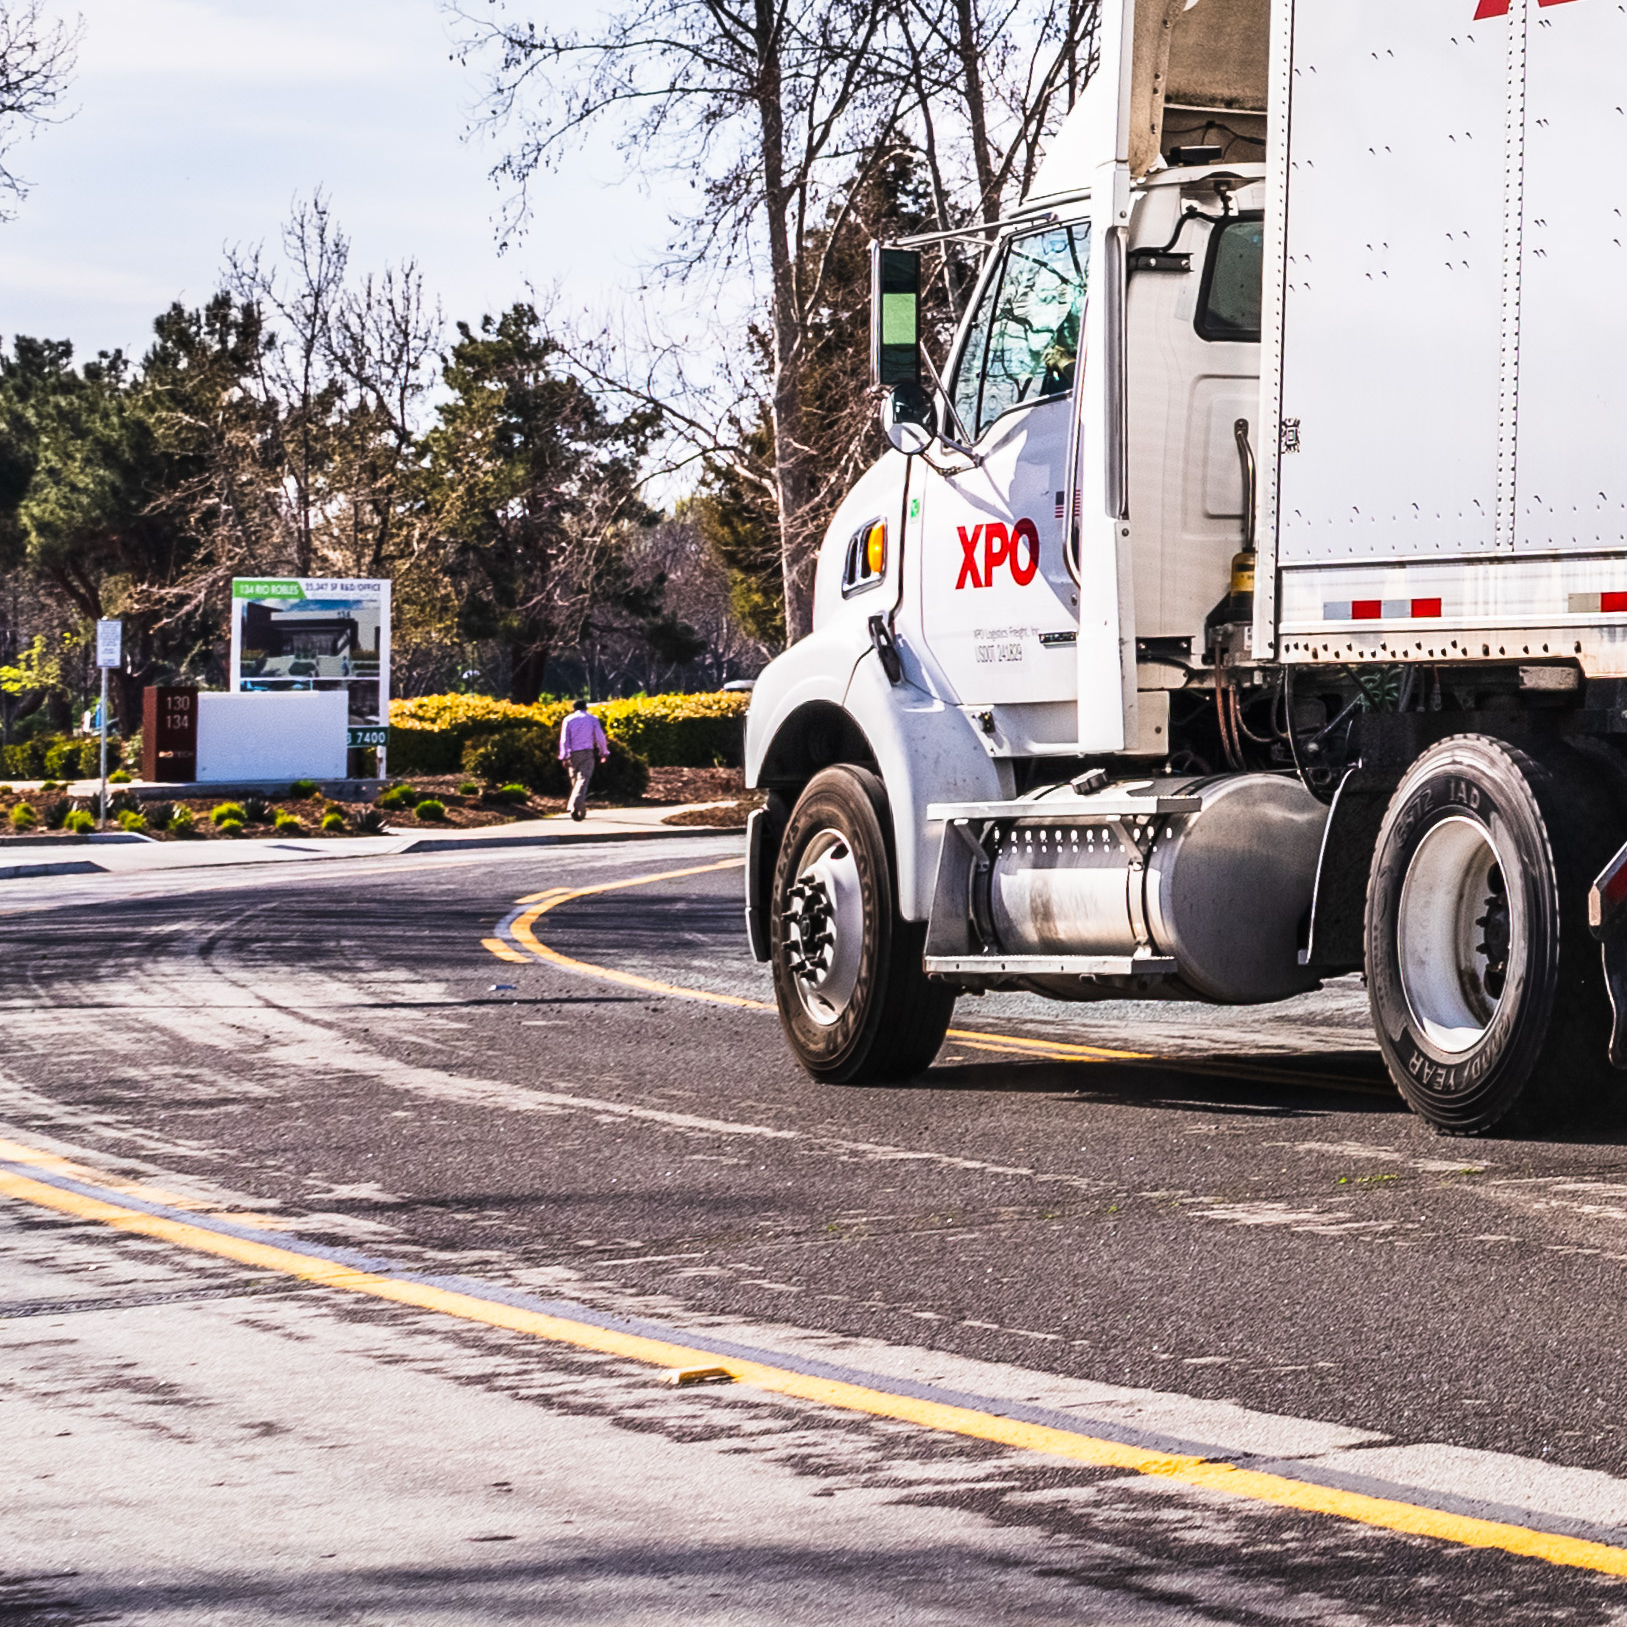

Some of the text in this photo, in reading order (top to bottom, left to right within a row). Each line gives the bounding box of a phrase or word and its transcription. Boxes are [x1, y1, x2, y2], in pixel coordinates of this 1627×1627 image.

[955, 518, 1040, 590] XPO
[167, 696, 190, 710] 130
[166, 715, 189, 729] 134
[356, 732, 386, 744] 7400
